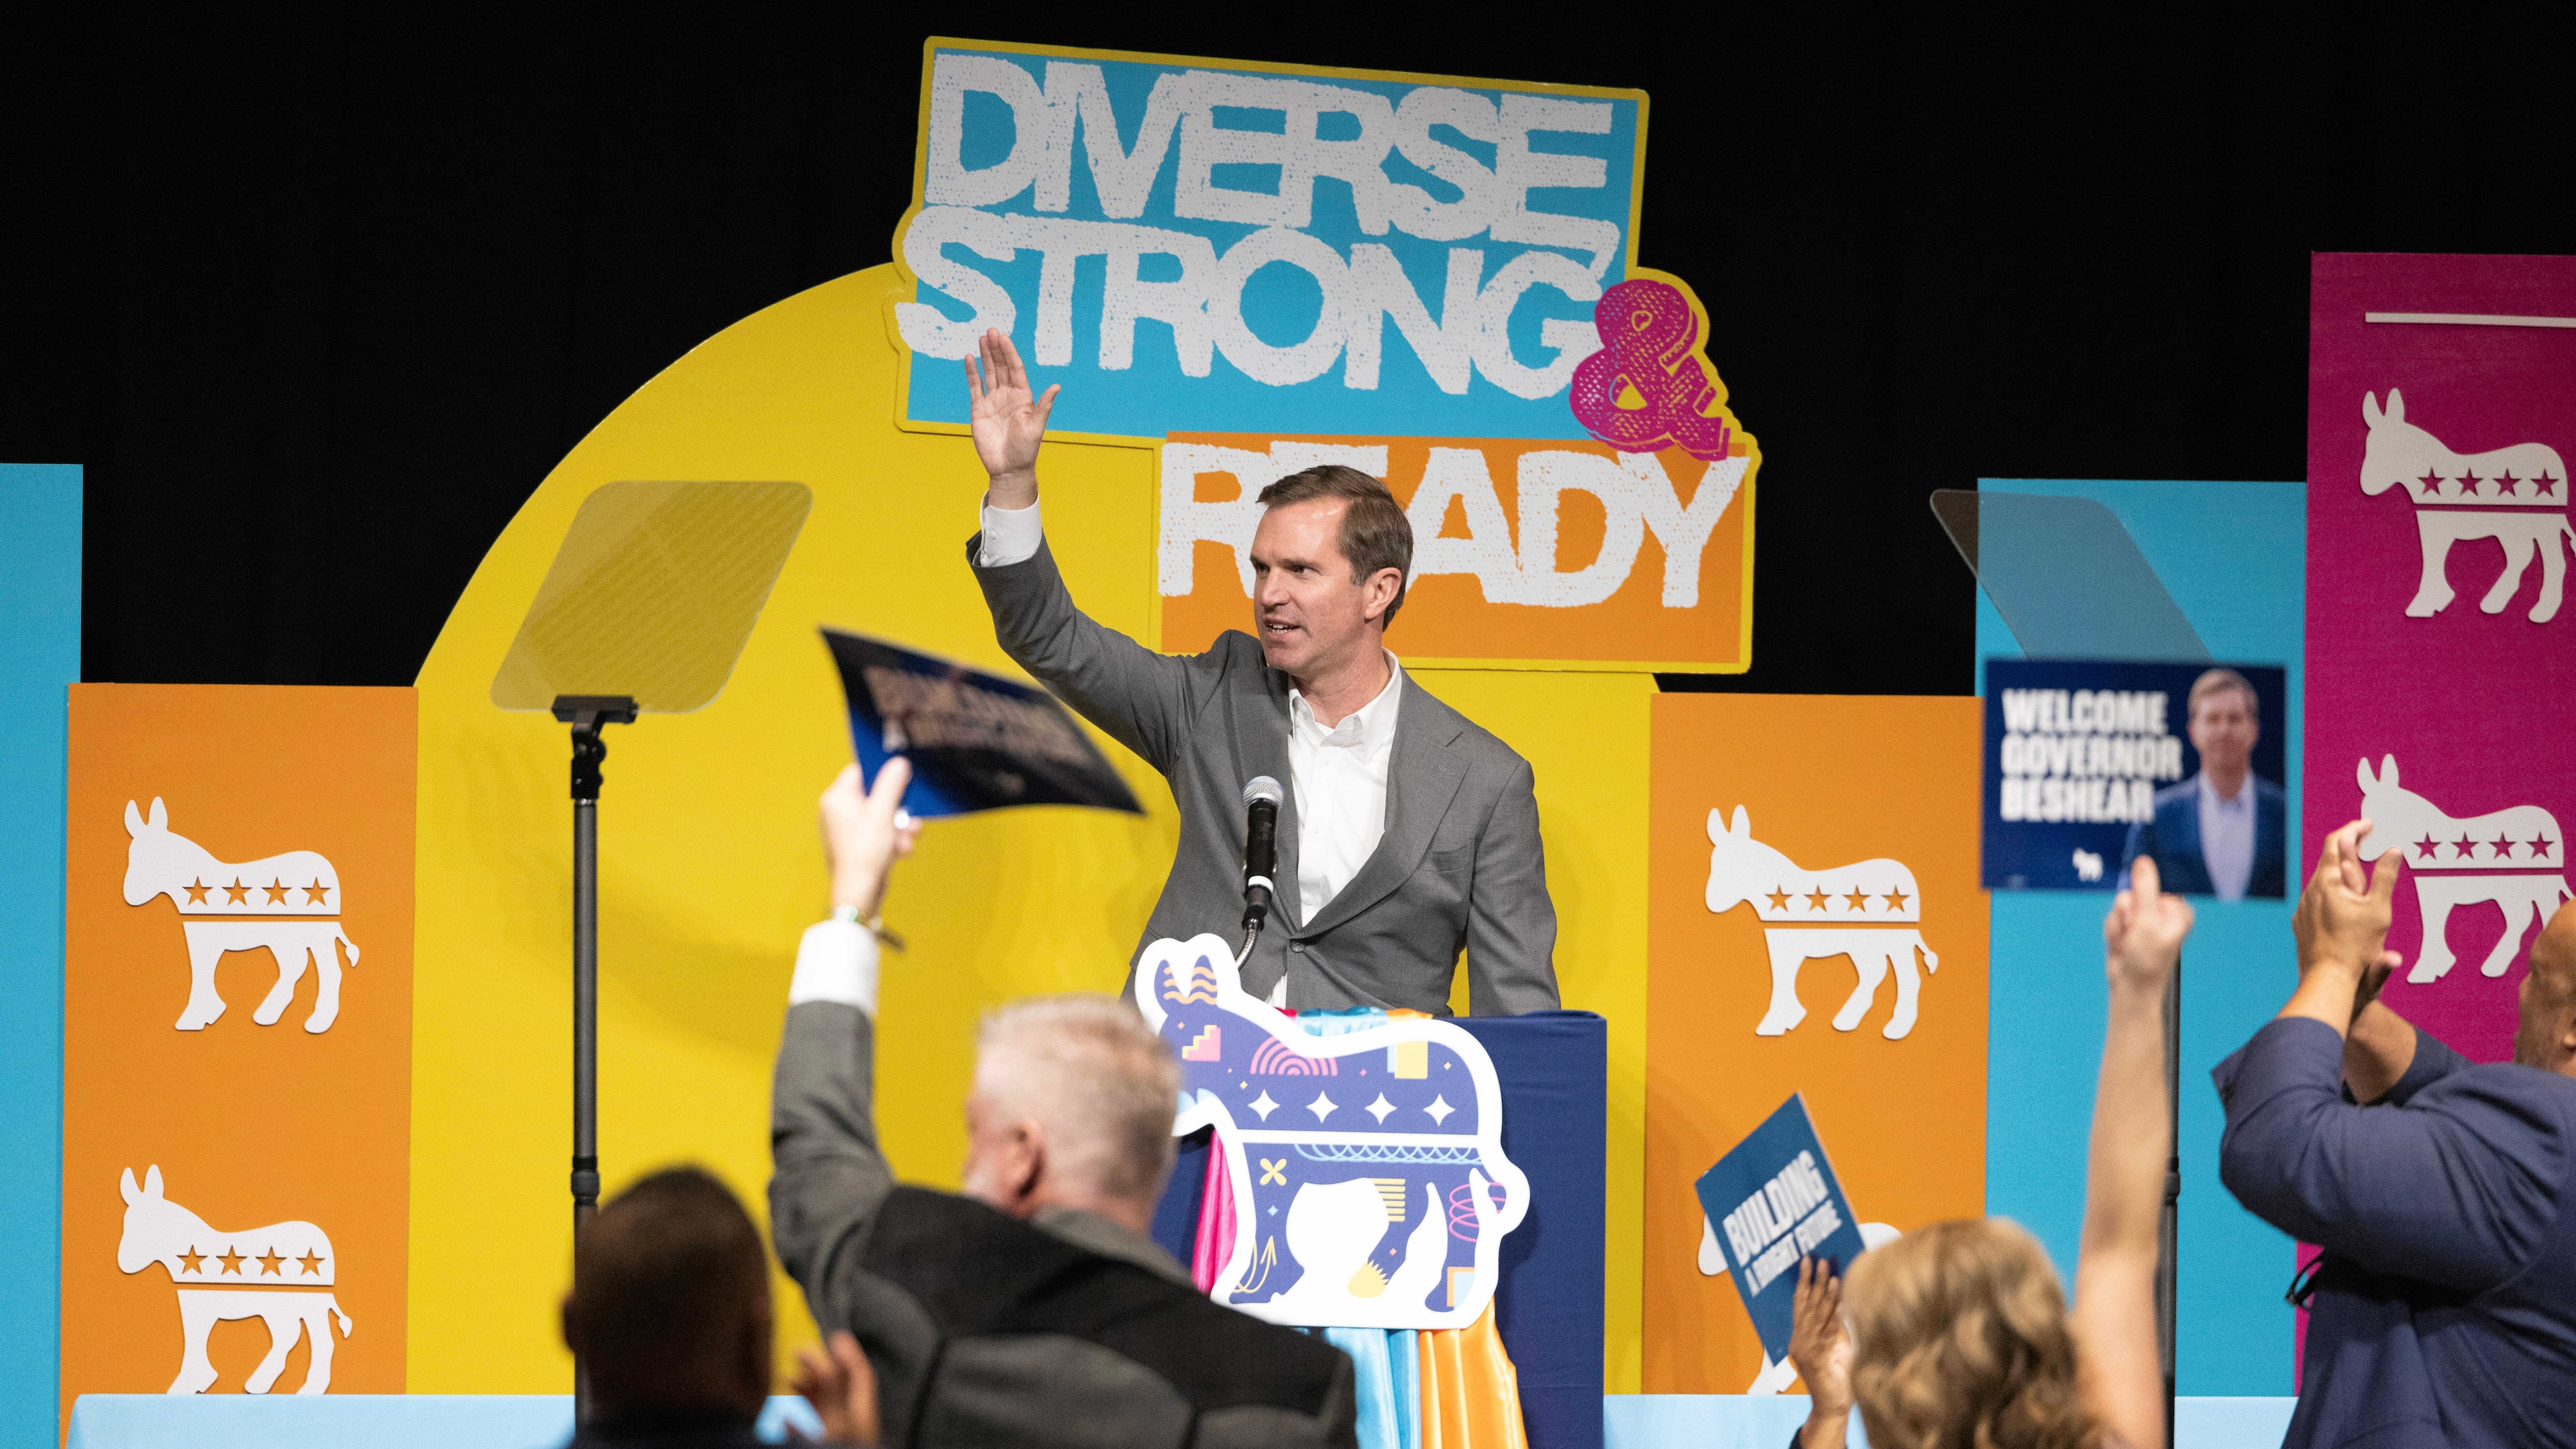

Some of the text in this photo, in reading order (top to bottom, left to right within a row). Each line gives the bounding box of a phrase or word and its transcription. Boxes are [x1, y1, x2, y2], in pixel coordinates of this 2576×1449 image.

[924, 54, 1619, 275] DIVERSE
[895, 205, 1731, 462] STRONG &
[2001, 690, 2169, 735] WELCOME
[2001, 735, 2183, 780] GOVERNOR
[2000, 779, 2155, 823] BESHEAR
[1722, 1149, 1829, 1269] BUILDING
[1744, 1267, 1762, 1298] A
